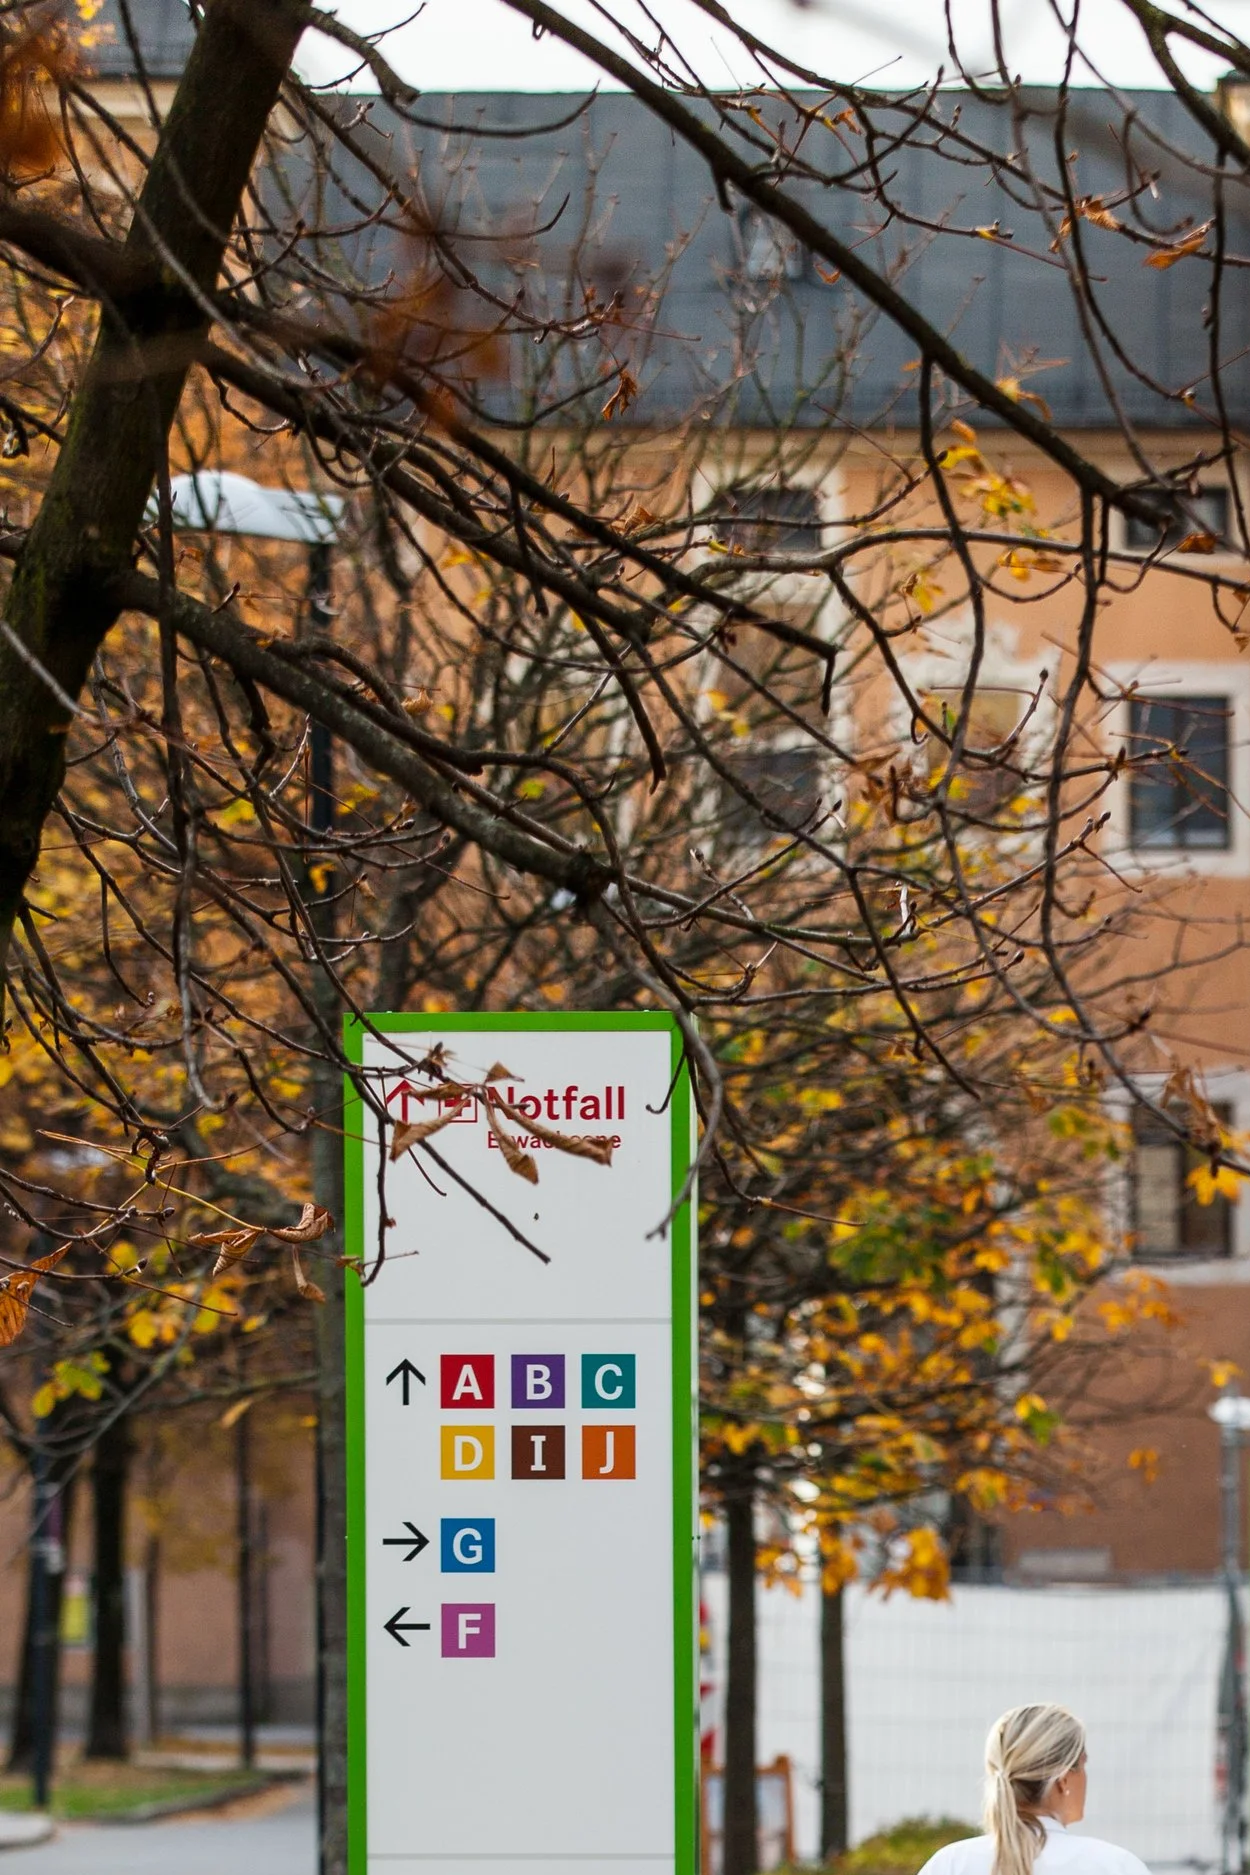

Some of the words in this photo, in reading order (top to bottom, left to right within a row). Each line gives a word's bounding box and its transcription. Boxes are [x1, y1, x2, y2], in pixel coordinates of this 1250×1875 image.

[488, 1085, 625, 1120] Notfall
[487, 1130, 621, 1149] Ewace
[453, 1365, 482, 1400] A
[527, 1365, 552, 1399] B
[595, 1364, 623, 1400] C
[455, 1436, 483, 1471] D
[531, 1436, 546, 1471] I
[600, 1432, 614, 1473] J
[453, 1528, 482, 1564] G
[459, 1614, 481, 1649] F
